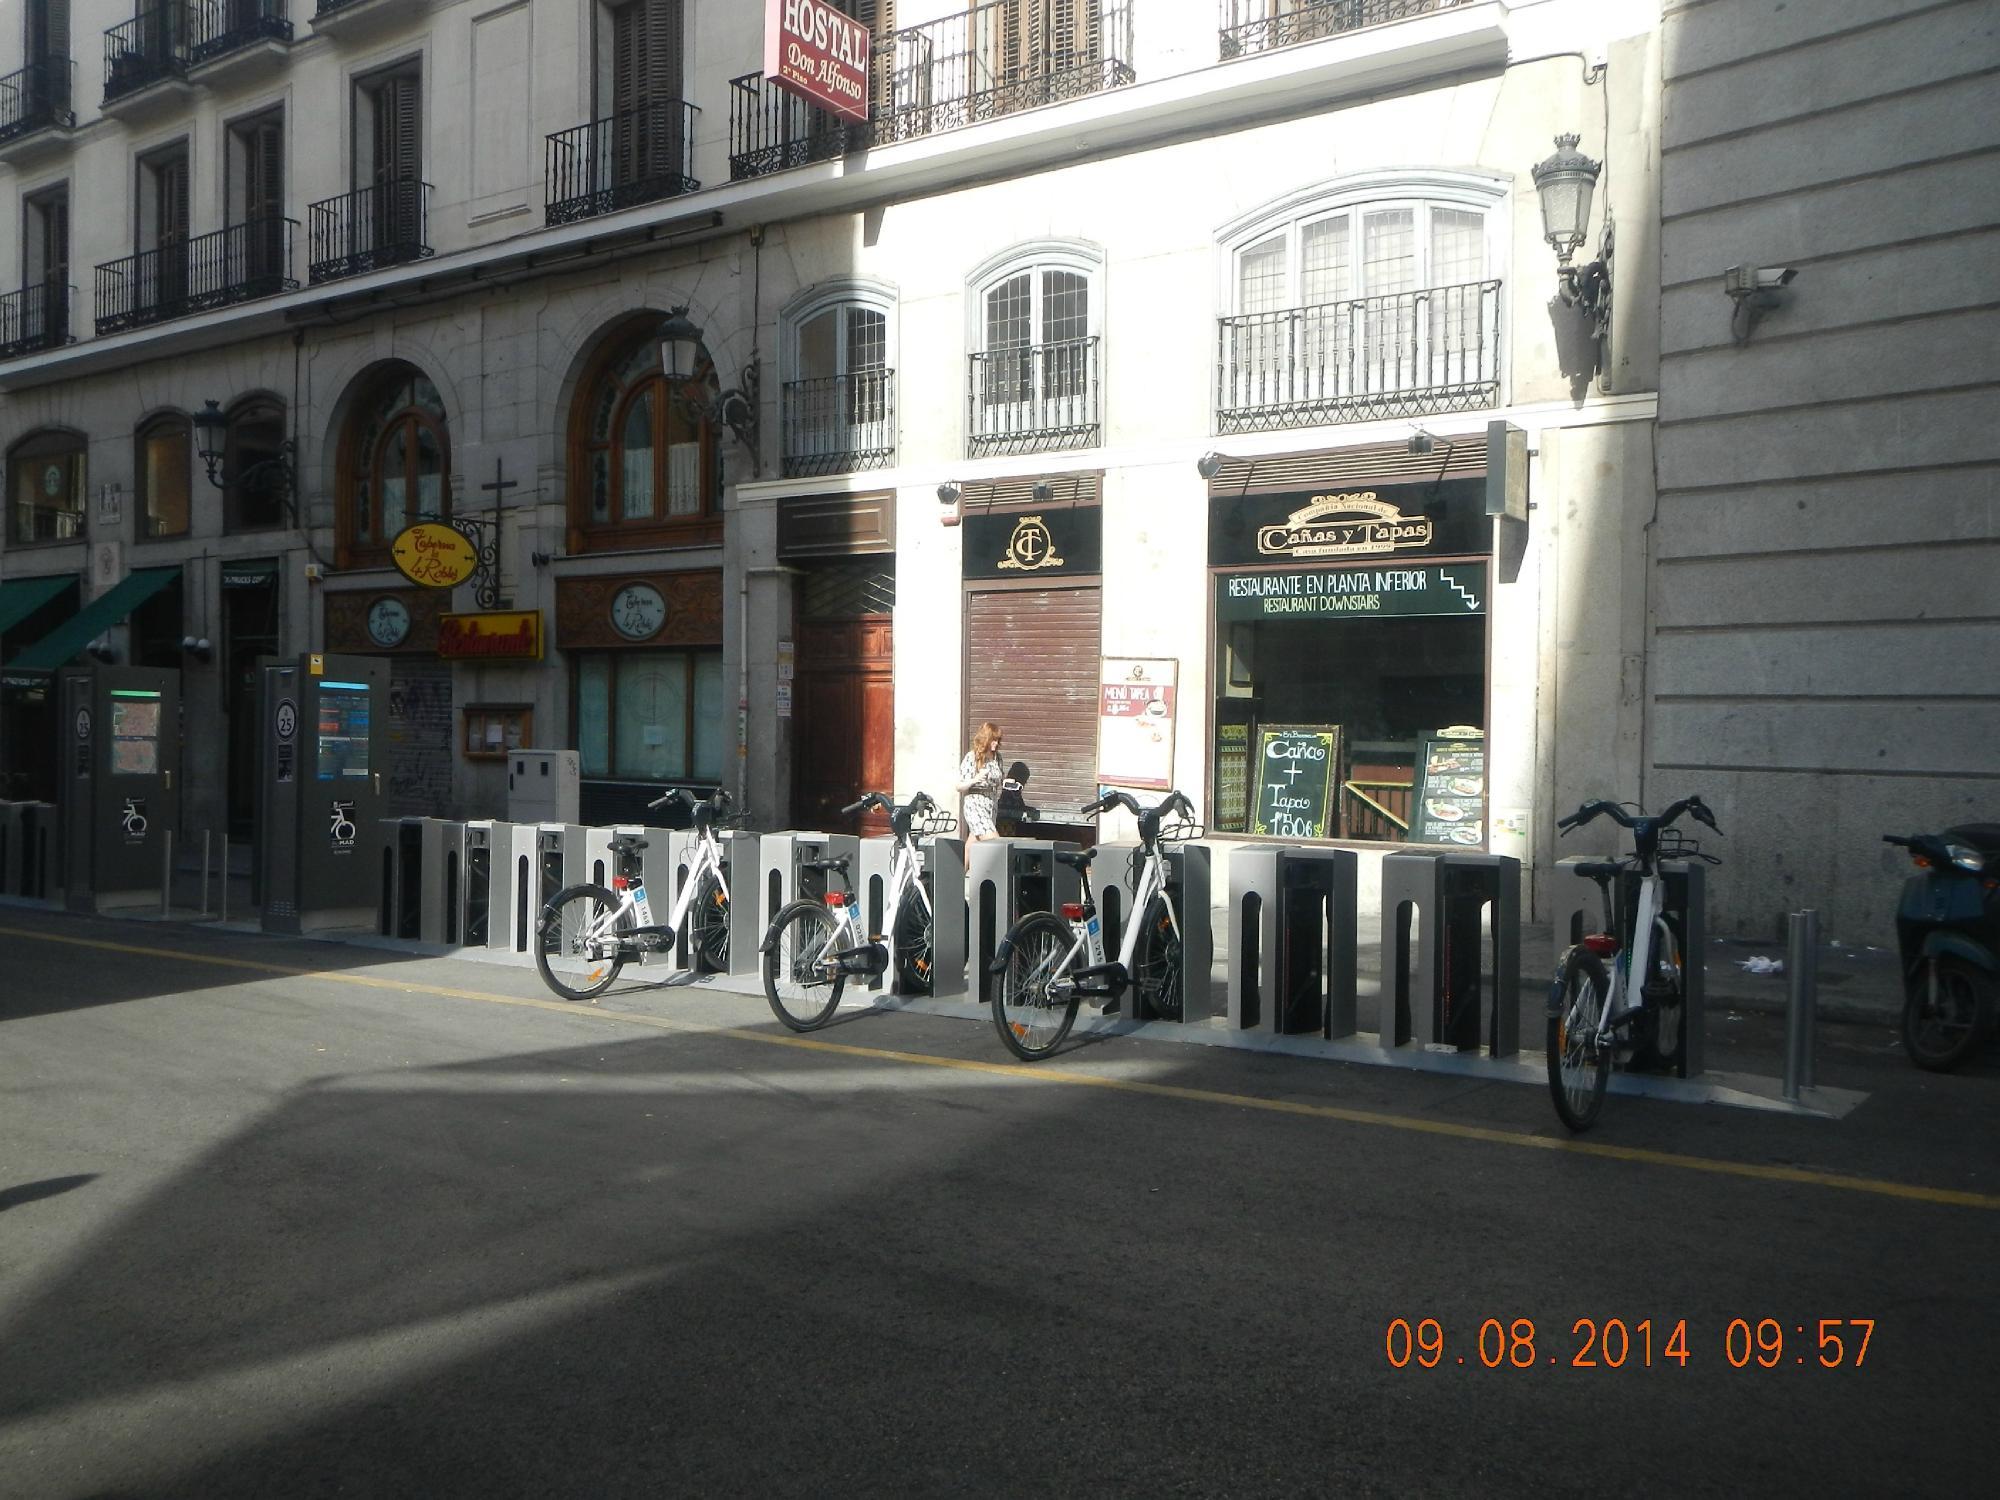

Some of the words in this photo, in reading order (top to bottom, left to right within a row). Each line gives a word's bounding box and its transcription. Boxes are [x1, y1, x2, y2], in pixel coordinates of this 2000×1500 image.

[783, 0, 866, 72] HOSTAL
[788, 43, 815, 75] Don
[816, 60, 862, 100] Alfonso
[414, 535, 456, 553] Taberna
[1263, 529, 1337, 550] Cañas
[1342, 529, 1354, 545] y
[1357, 523, 1428, 544] Tapas
[1228, 575, 1303, 597] RESTAURANTE
[1306, 574, 1324, 594] EN
[1327, 572, 1371, 593] PLANTA
[1375, 570, 1427, 592] INFERIOR
[1263, 596, 1319, 613] RESTAURANT
[1320, 594, 1381, 612] DOWNSTAIRS
[281, 718, 293, 733] 25
[1265, 740, 1326, 761] Caña
[1267, 783, 1311, 814] Tapa
